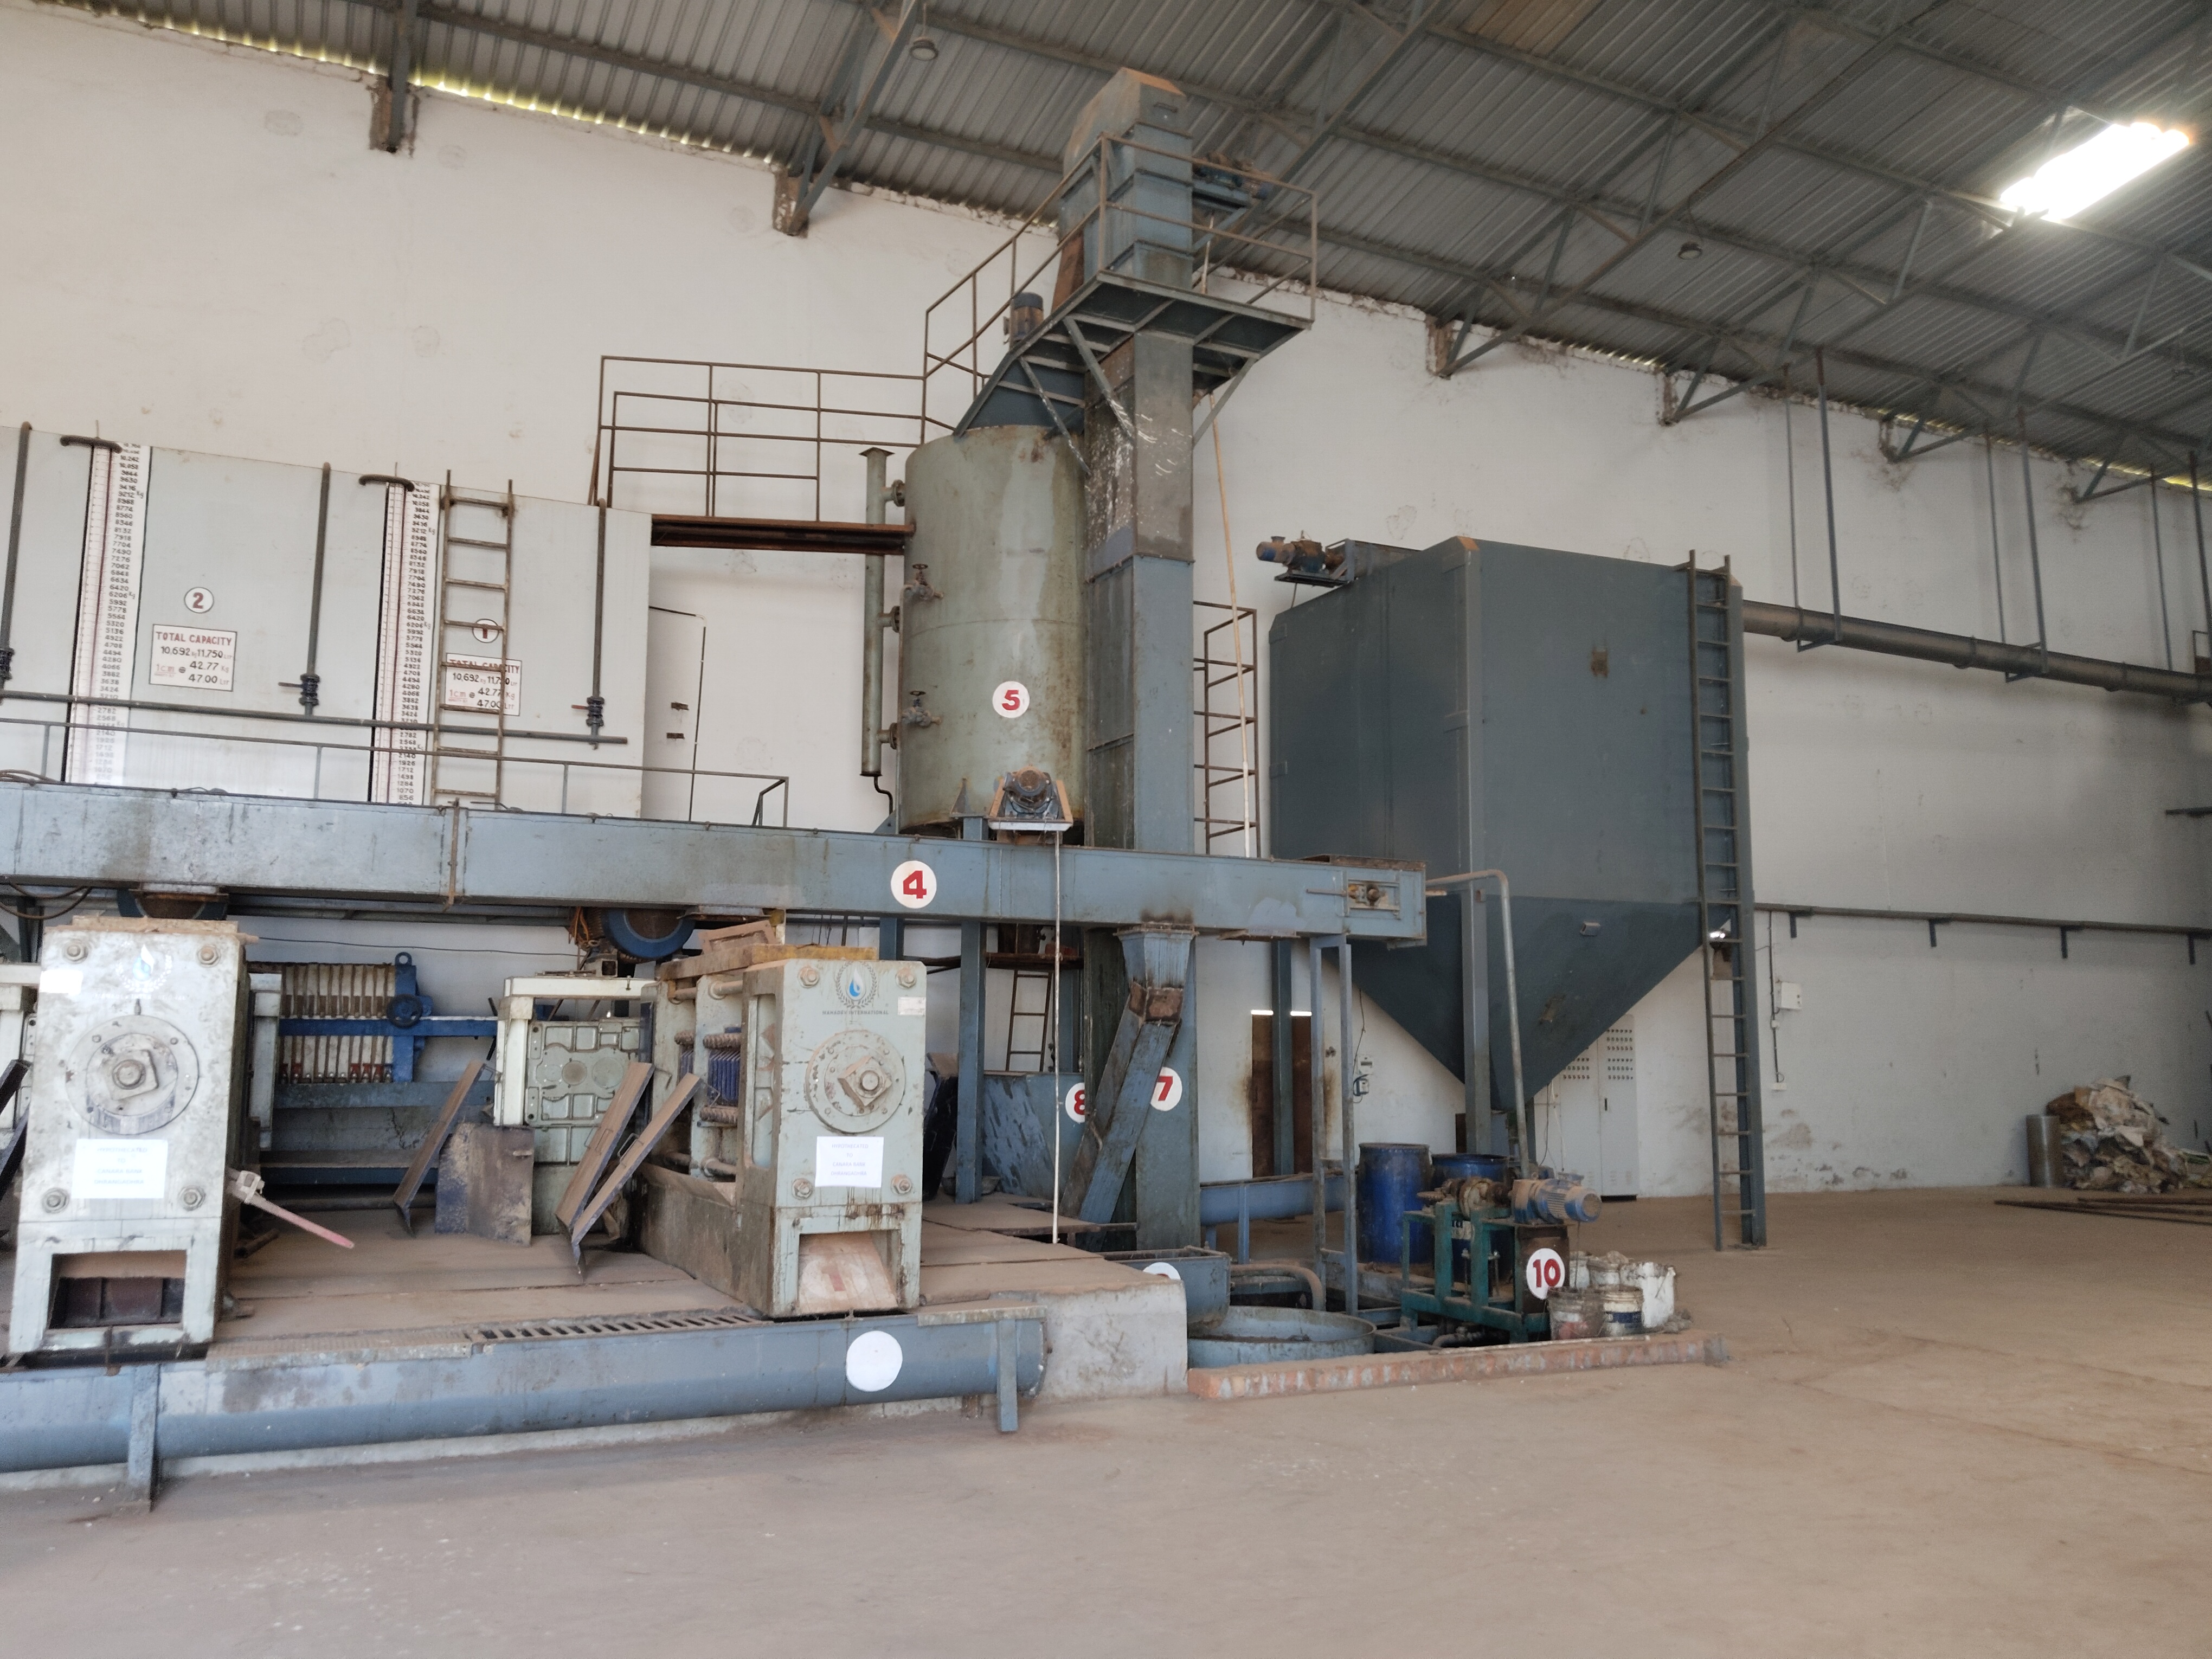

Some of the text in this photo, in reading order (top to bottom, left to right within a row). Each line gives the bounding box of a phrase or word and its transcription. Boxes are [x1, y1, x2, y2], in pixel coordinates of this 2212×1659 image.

[192, 592, 204, 609] 2
[156, 632, 232, 646] TOTAL CAPACITY
[221, 665, 229, 673] Kg
[1002, 689, 1020, 711] 5
[903, 870, 927, 899] 4
[1156, 1076, 1173, 1101] 7
[1074, 1090, 1085, 1115] 8
[1533, 1258, 1561, 1288] 10
